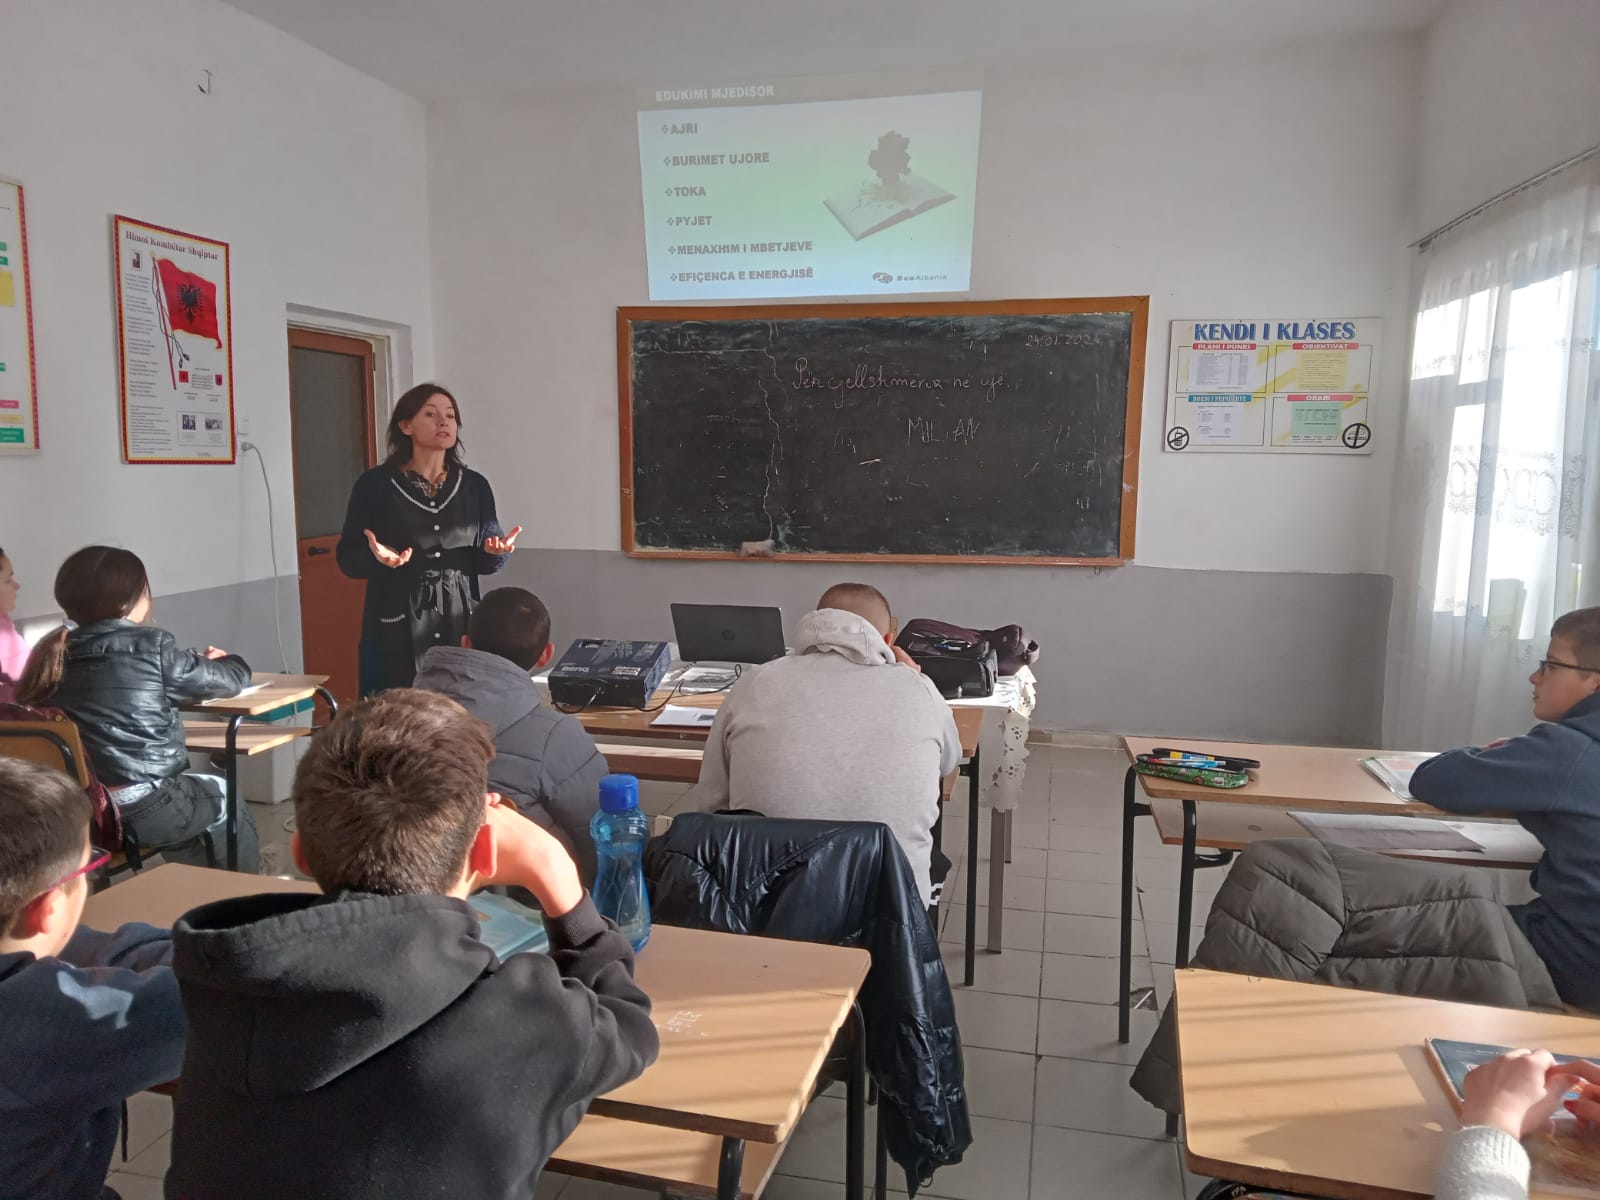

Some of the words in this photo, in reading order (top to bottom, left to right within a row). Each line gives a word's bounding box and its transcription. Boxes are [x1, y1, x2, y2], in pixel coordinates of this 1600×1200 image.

[655, 88, 708, 102] EDUKIMI
[711, 85, 775, 99] MJEDISOR
[670, 122, 698, 134] AJRI
[672, 154, 726, 167] BURIMET
[728, 152, 770, 165] UJORE
[673, 186, 706, 197] TOKA
[675, 215, 713, 227] PYJET
[677, 244, 740, 255] MENAXHIM
[750, 241, 813, 253] MBETJEVE
[678, 271, 736, 283] EFIÇENCA
[738, 271, 746, 281] E
[749, 266, 814, 280] ENERGJISË
[1194, 323, 1256, 341] KENDI
[1263, 323, 1270, 341] I
[1277, 321, 1356, 341] KLASES
